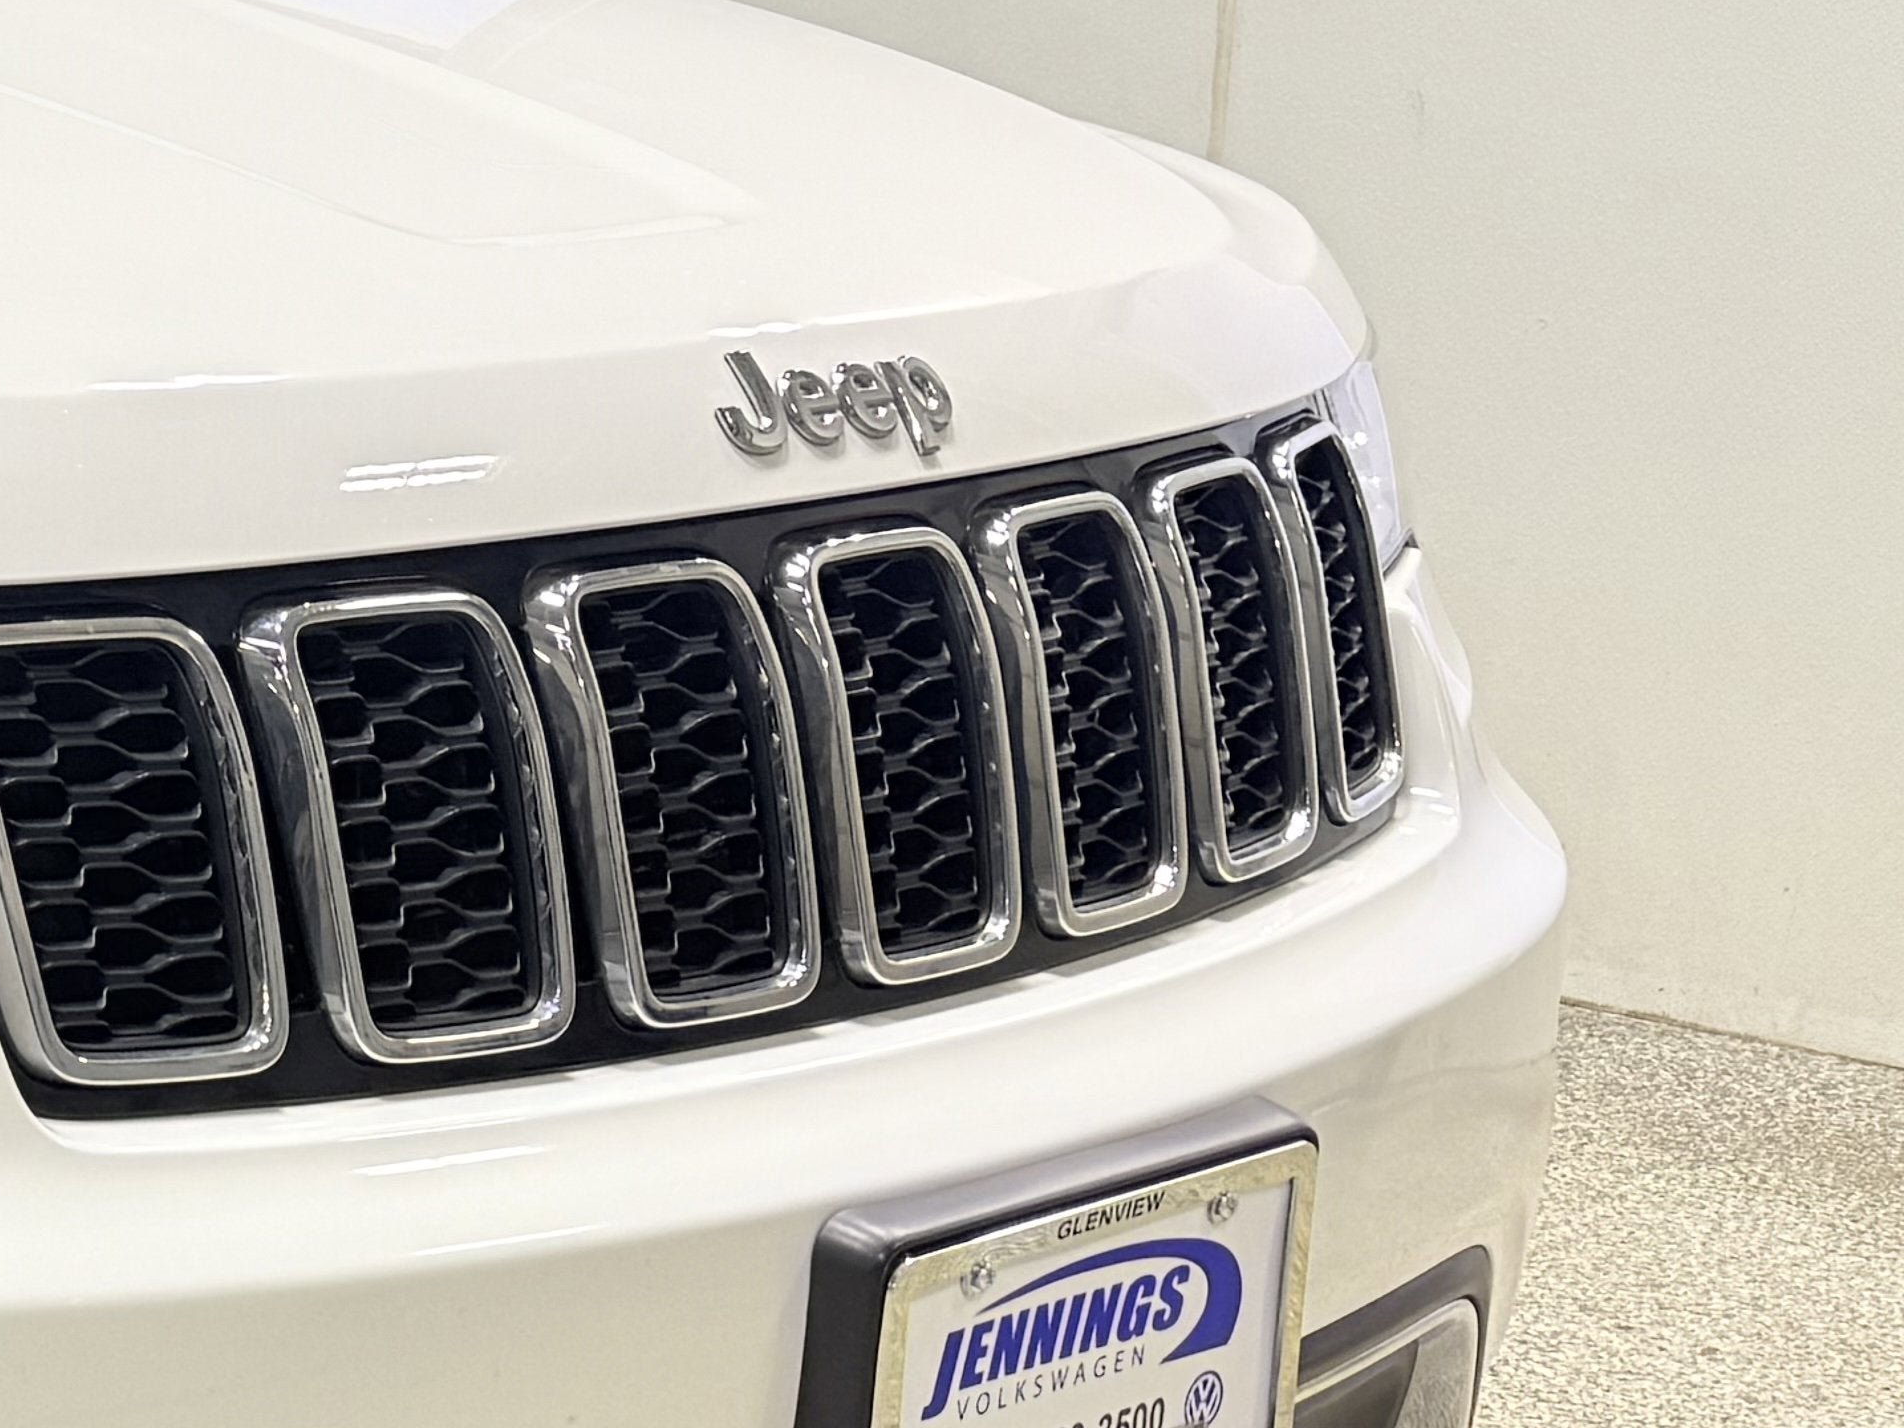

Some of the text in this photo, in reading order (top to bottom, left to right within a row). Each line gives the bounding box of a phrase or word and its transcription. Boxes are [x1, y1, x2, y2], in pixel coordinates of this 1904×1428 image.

[715, 349, 953, 457] Jeep
[1055, 1191, 1166, 1242] GLENVIEW
[921, 1264, 1191, 1421] JENNINGS
[956, 1344, 1146, 1422] VOLKSWAGEN
